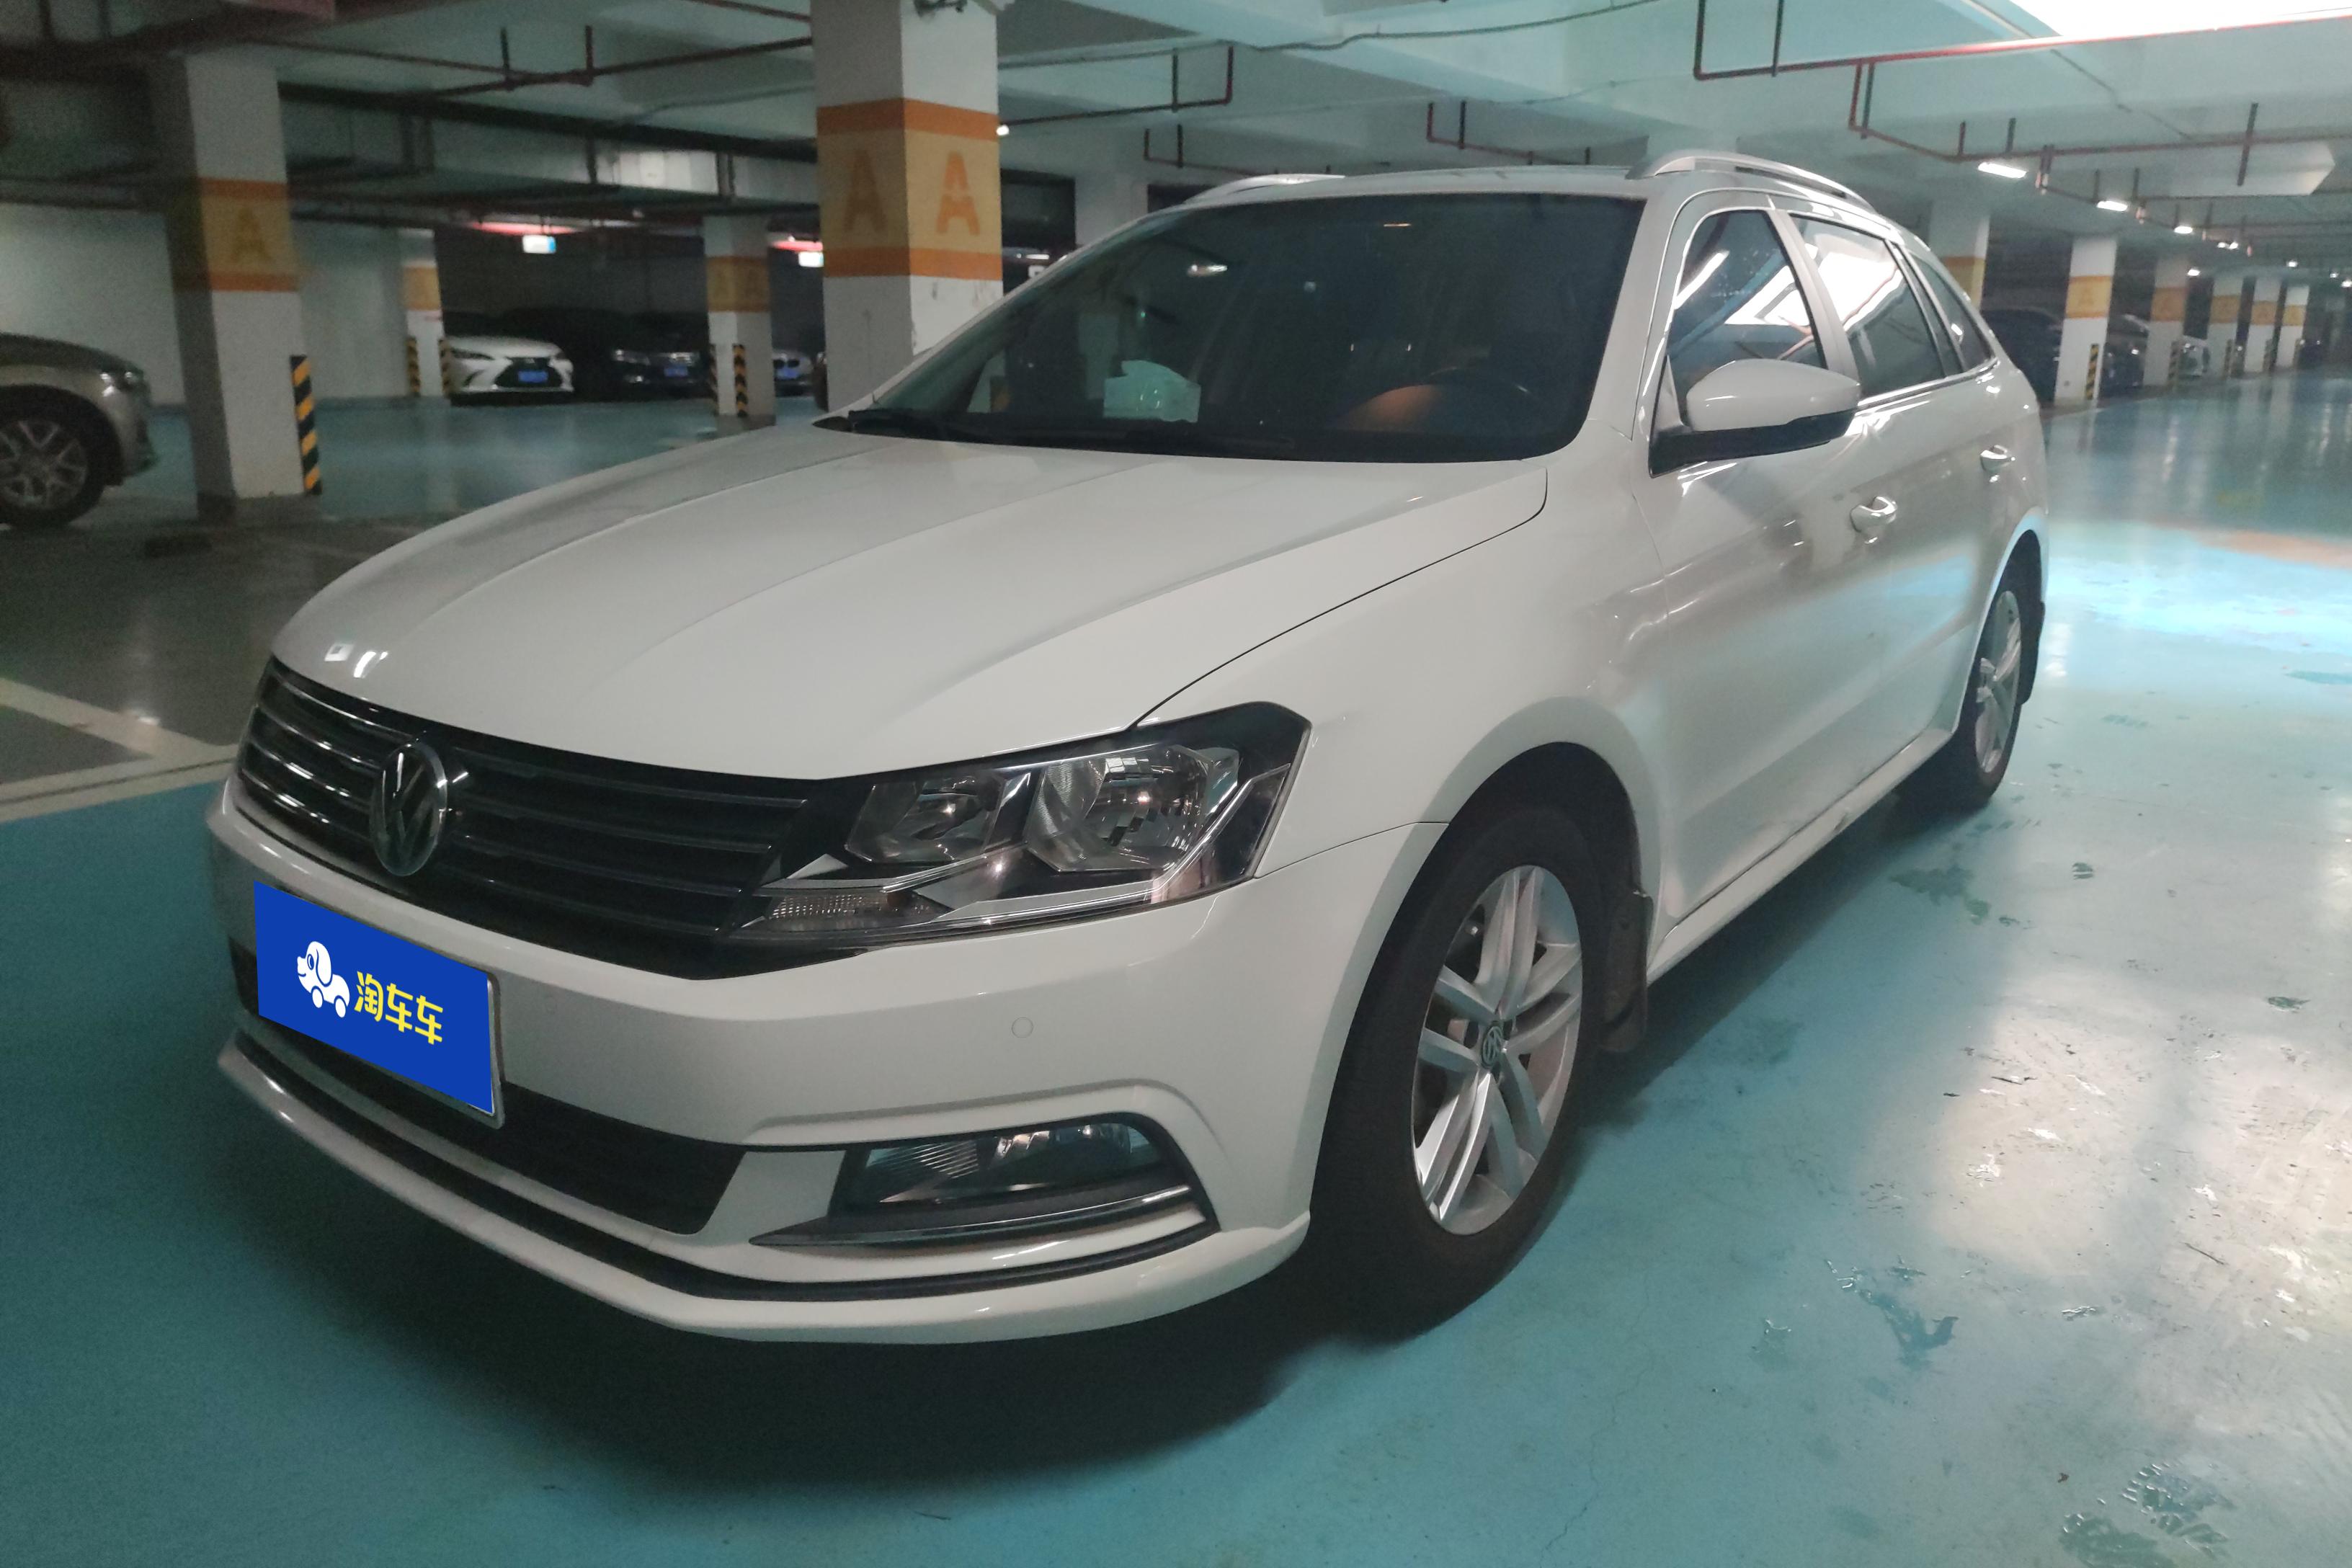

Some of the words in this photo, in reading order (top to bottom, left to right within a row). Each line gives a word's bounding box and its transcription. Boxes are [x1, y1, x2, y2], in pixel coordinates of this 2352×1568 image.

[843, 148, 888, 232] A
[936, 151, 981, 235] A
[231, 206, 272, 263] A
